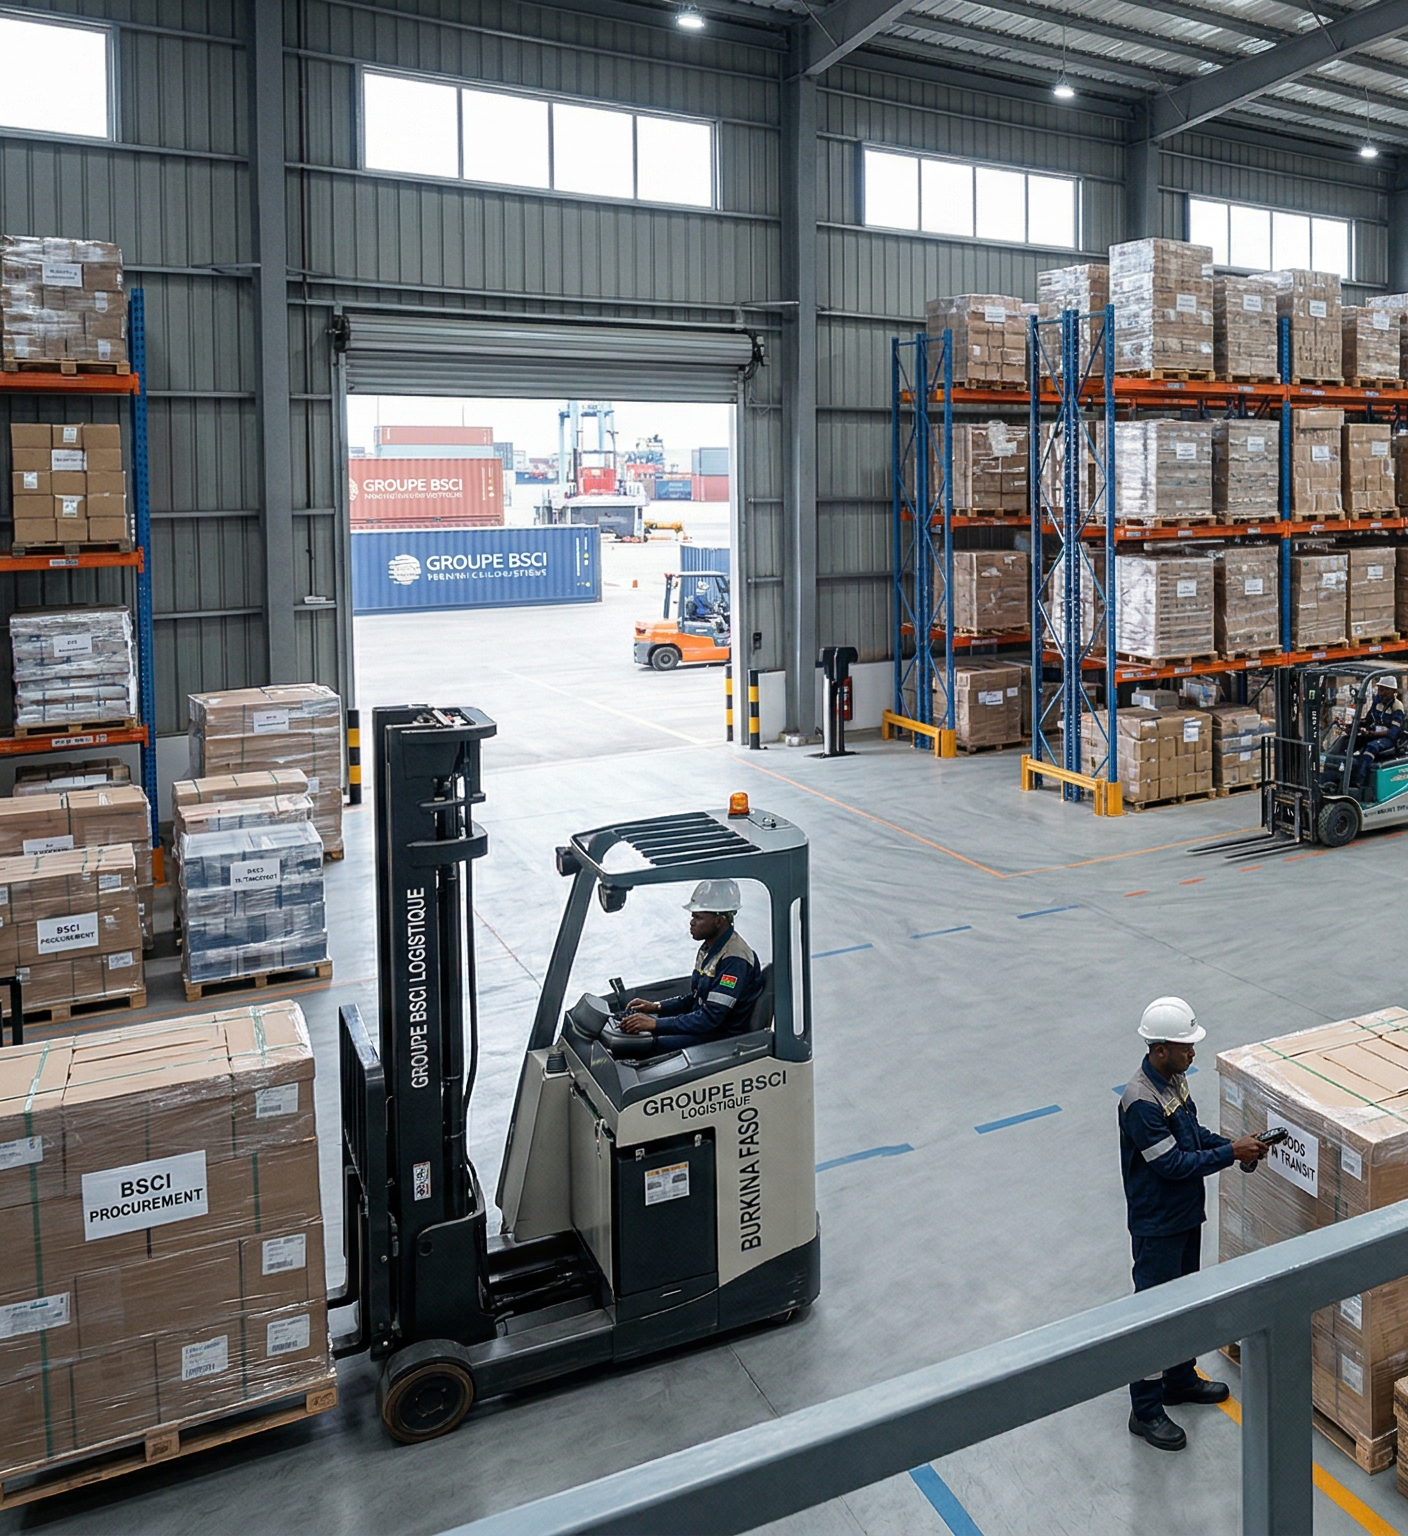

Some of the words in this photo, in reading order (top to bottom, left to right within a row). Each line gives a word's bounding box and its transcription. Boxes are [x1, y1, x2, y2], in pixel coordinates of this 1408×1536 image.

[363, 478, 427, 492] GROUPE
[430, 478, 463, 491] BSCI
[426, 553, 504, 571] GROUPE
[508, 552, 547, 568] BSCI
[407, 887, 427, 983] LOGISTIQUE
[409, 986, 427, 1023] BSCI
[410, 1024, 429, 1089] GROUPE
[643, 1082, 735, 1117] GROUPE
[741, 1070, 787, 1095] BSCI
[681, 1095, 751, 1120] LOGISTIQUE
[737, 1108, 760, 1159] FASO
[1280, 1149, 1316, 1181] TRANSIT
[120, 1172, 171, 1198] BSCI
[89, 1188, 203, 1223] PROCUREMENT
[739, 1160, 762, 1252] BURKINA
